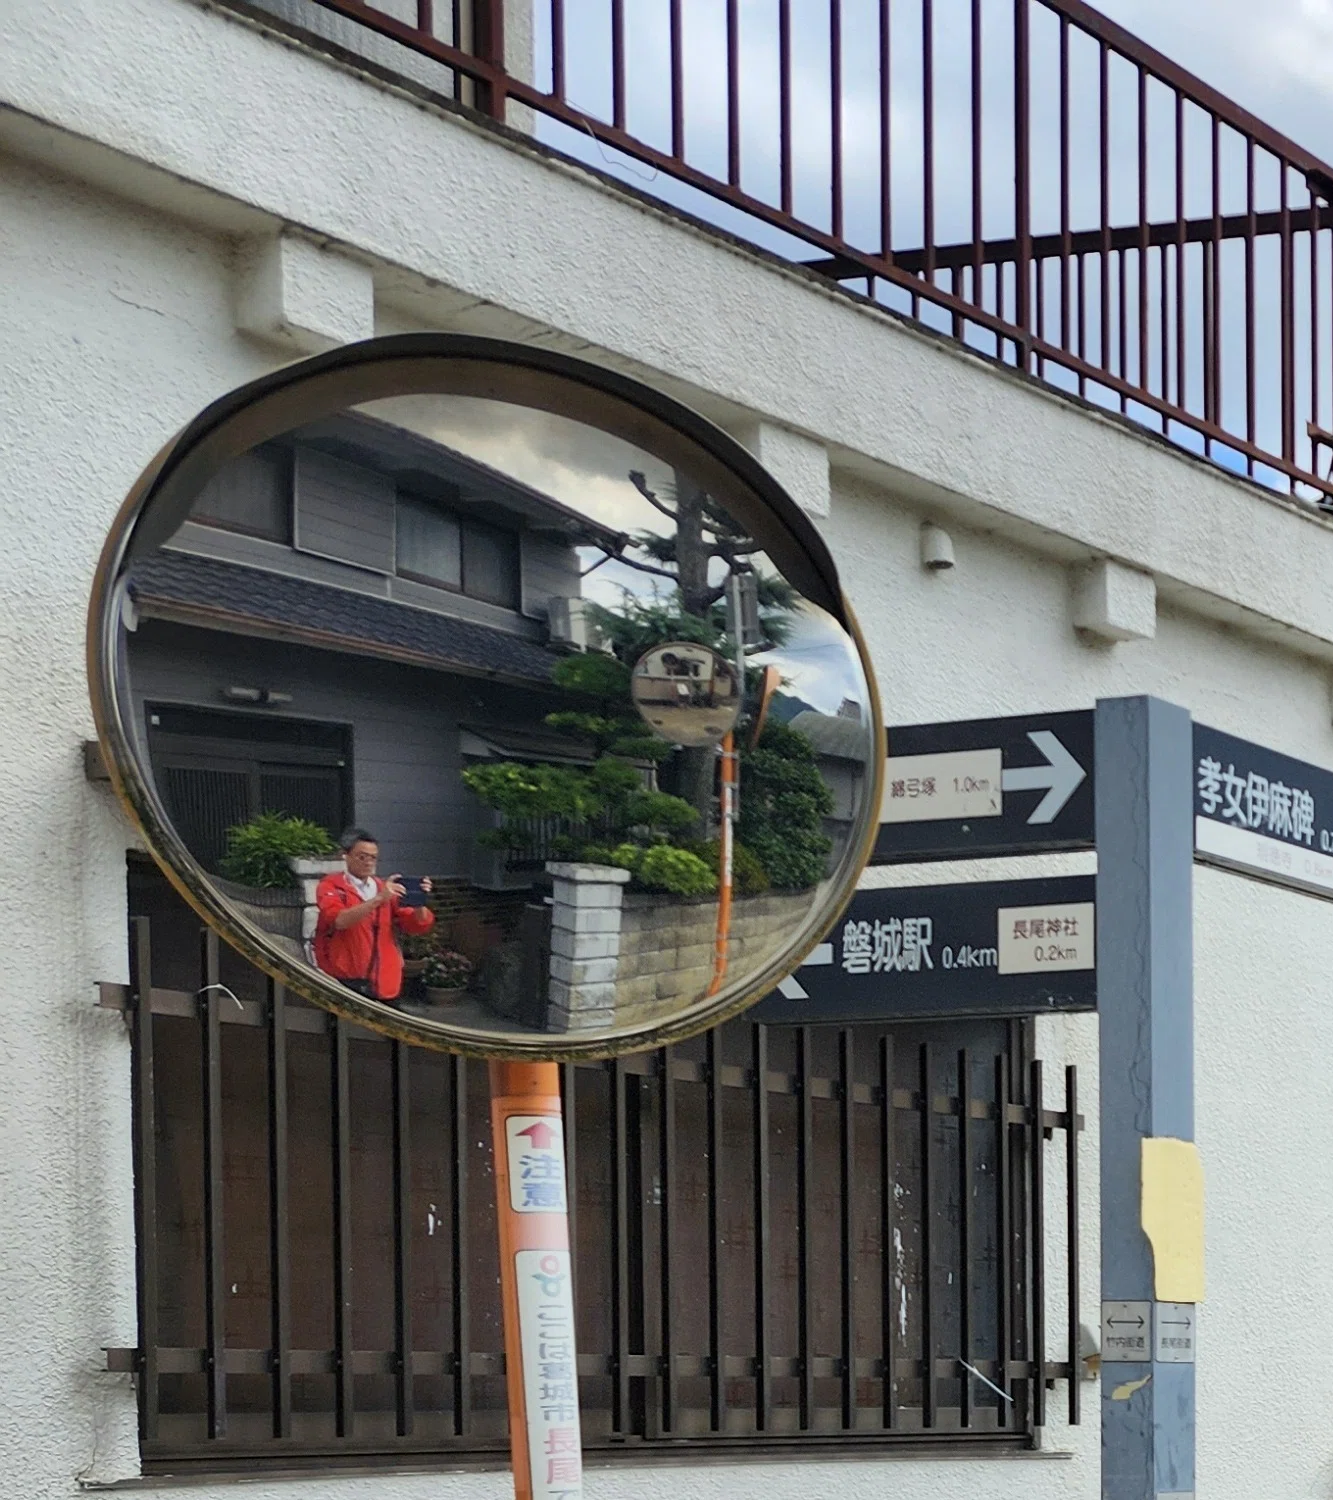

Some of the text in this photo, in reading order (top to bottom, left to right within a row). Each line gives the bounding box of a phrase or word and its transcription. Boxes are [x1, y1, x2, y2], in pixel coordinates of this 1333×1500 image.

[953, 776, 990, 793] 1.0km
[1198, 756, 1315, 845] 孝女伊麻碑
[842, 918, 998, 973] 磐城駅 0.4km
[1013, 917, 1079, 940] 長尾神社
[1034, 945, 1077, 962] 0.2km
[518, 1154, 564, 1207] 注意
